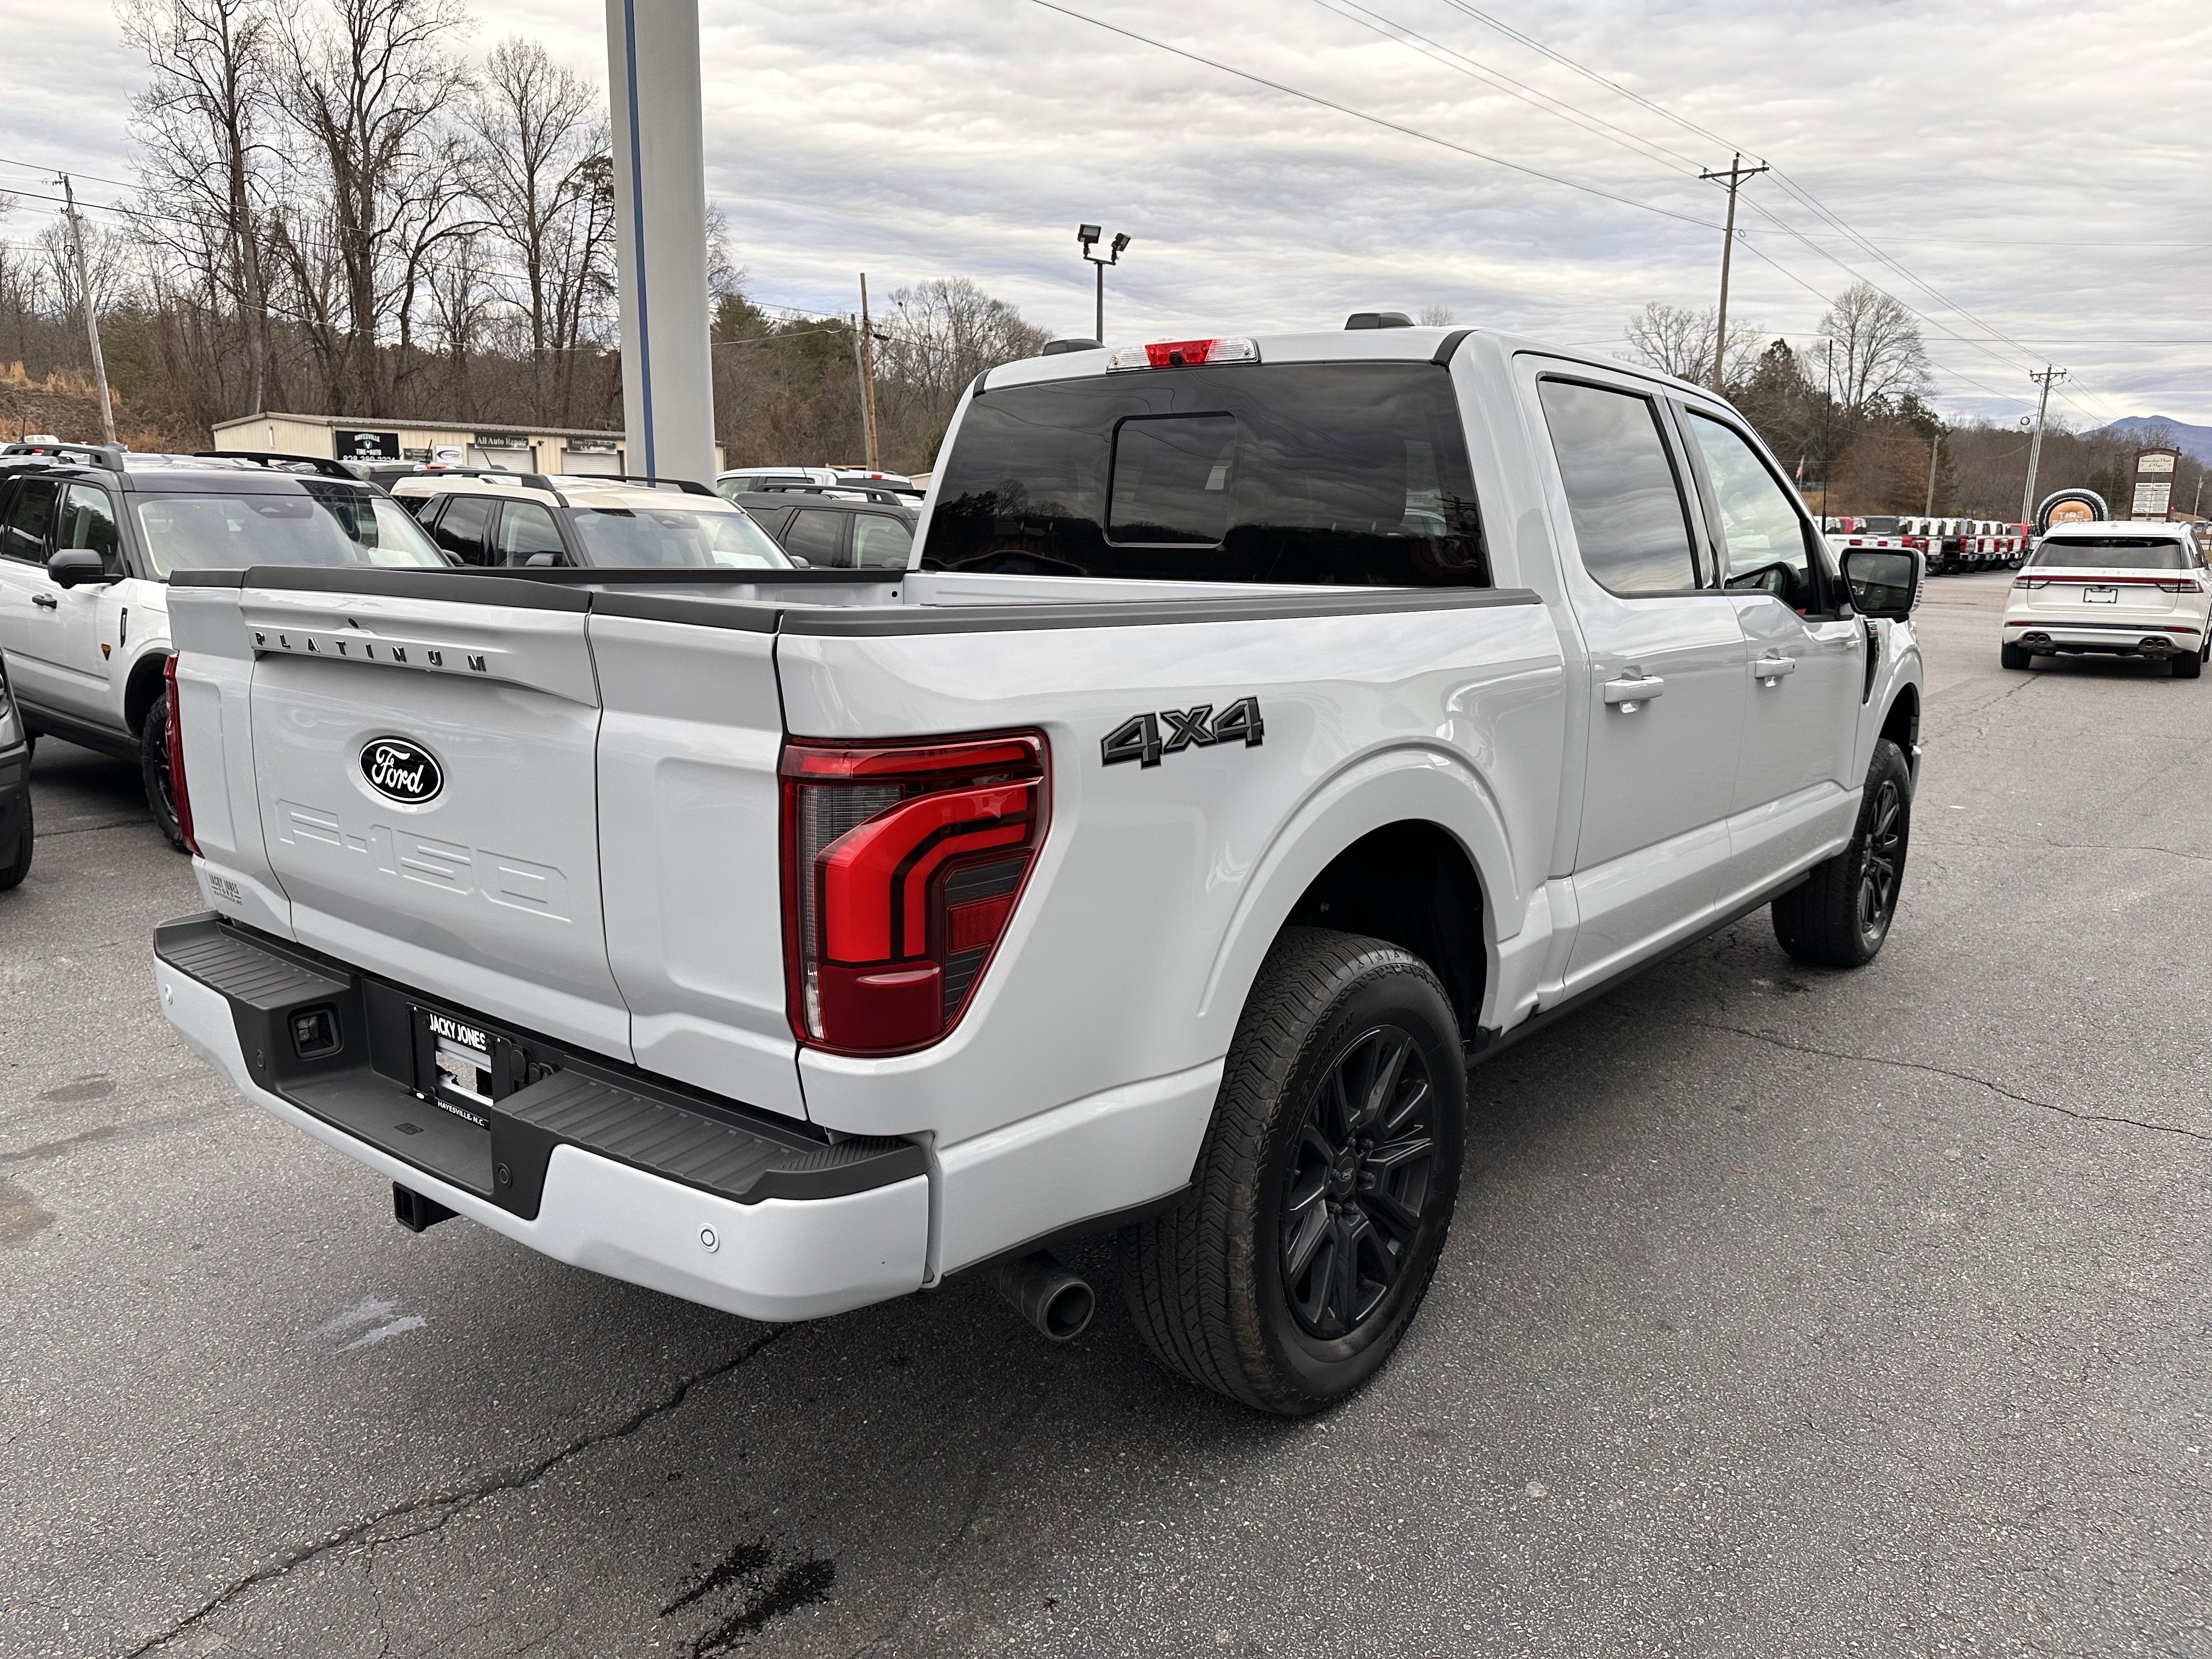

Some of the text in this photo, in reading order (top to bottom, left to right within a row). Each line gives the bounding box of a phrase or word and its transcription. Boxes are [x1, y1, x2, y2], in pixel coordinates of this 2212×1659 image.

[505, 438, 527, 447] Repair
[2057, 511, 2084, 519] TIRE
[255, 631, 487, 672] PLATINUM
[371, 746, 425, 793] Ford
[275, 799, 572, 923] F-150
[430, 1013, 487, 1051] JACKY JONES
[438, 1100, 484, 1127] HAYESVILLE, N.C.
